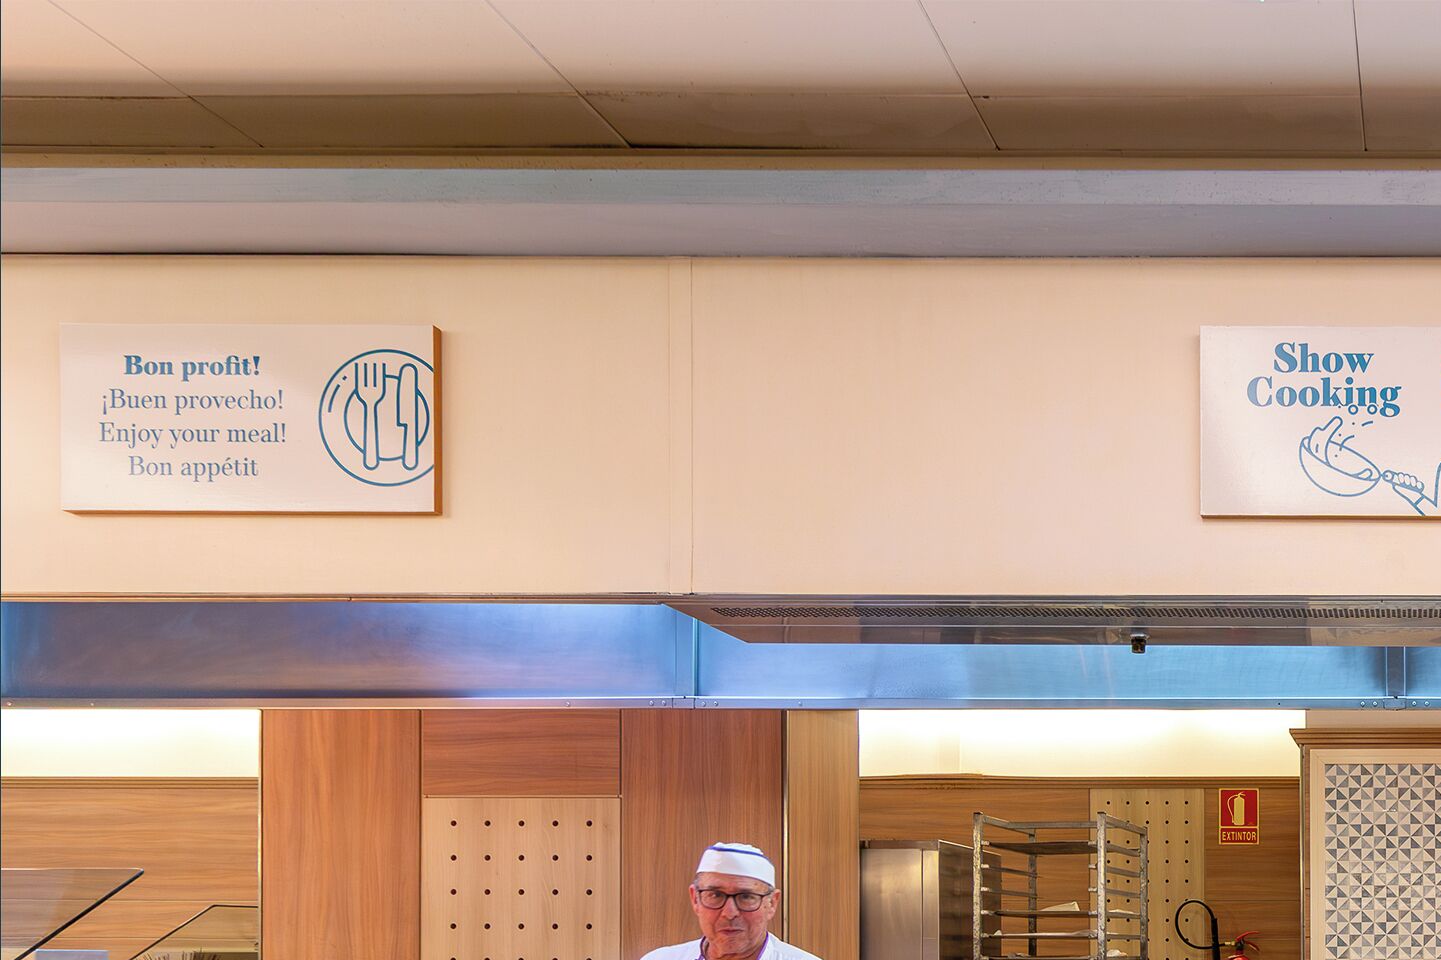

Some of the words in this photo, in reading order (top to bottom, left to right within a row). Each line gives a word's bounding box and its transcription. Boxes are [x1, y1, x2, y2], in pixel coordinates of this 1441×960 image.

[123, 354, 174, 376] Bon
[181, 354, 261, 383] profit!
[1273, 342, 1375, 374] Show
[101, 388, 168, 414] ¡Buen
[174, 388, 284, 415] provecho!
[1246, 375, 1402, 418] Cooking
[98, 421, 164, 449] Enjoy
[168, 427, 220, 449] your
[226, 421, 287, 444] meal!
[128, 455, 173, 476] Bon
[180, 455, 259, 482] appétit
[1222, 831, 1257, 841] EXTINTOR
